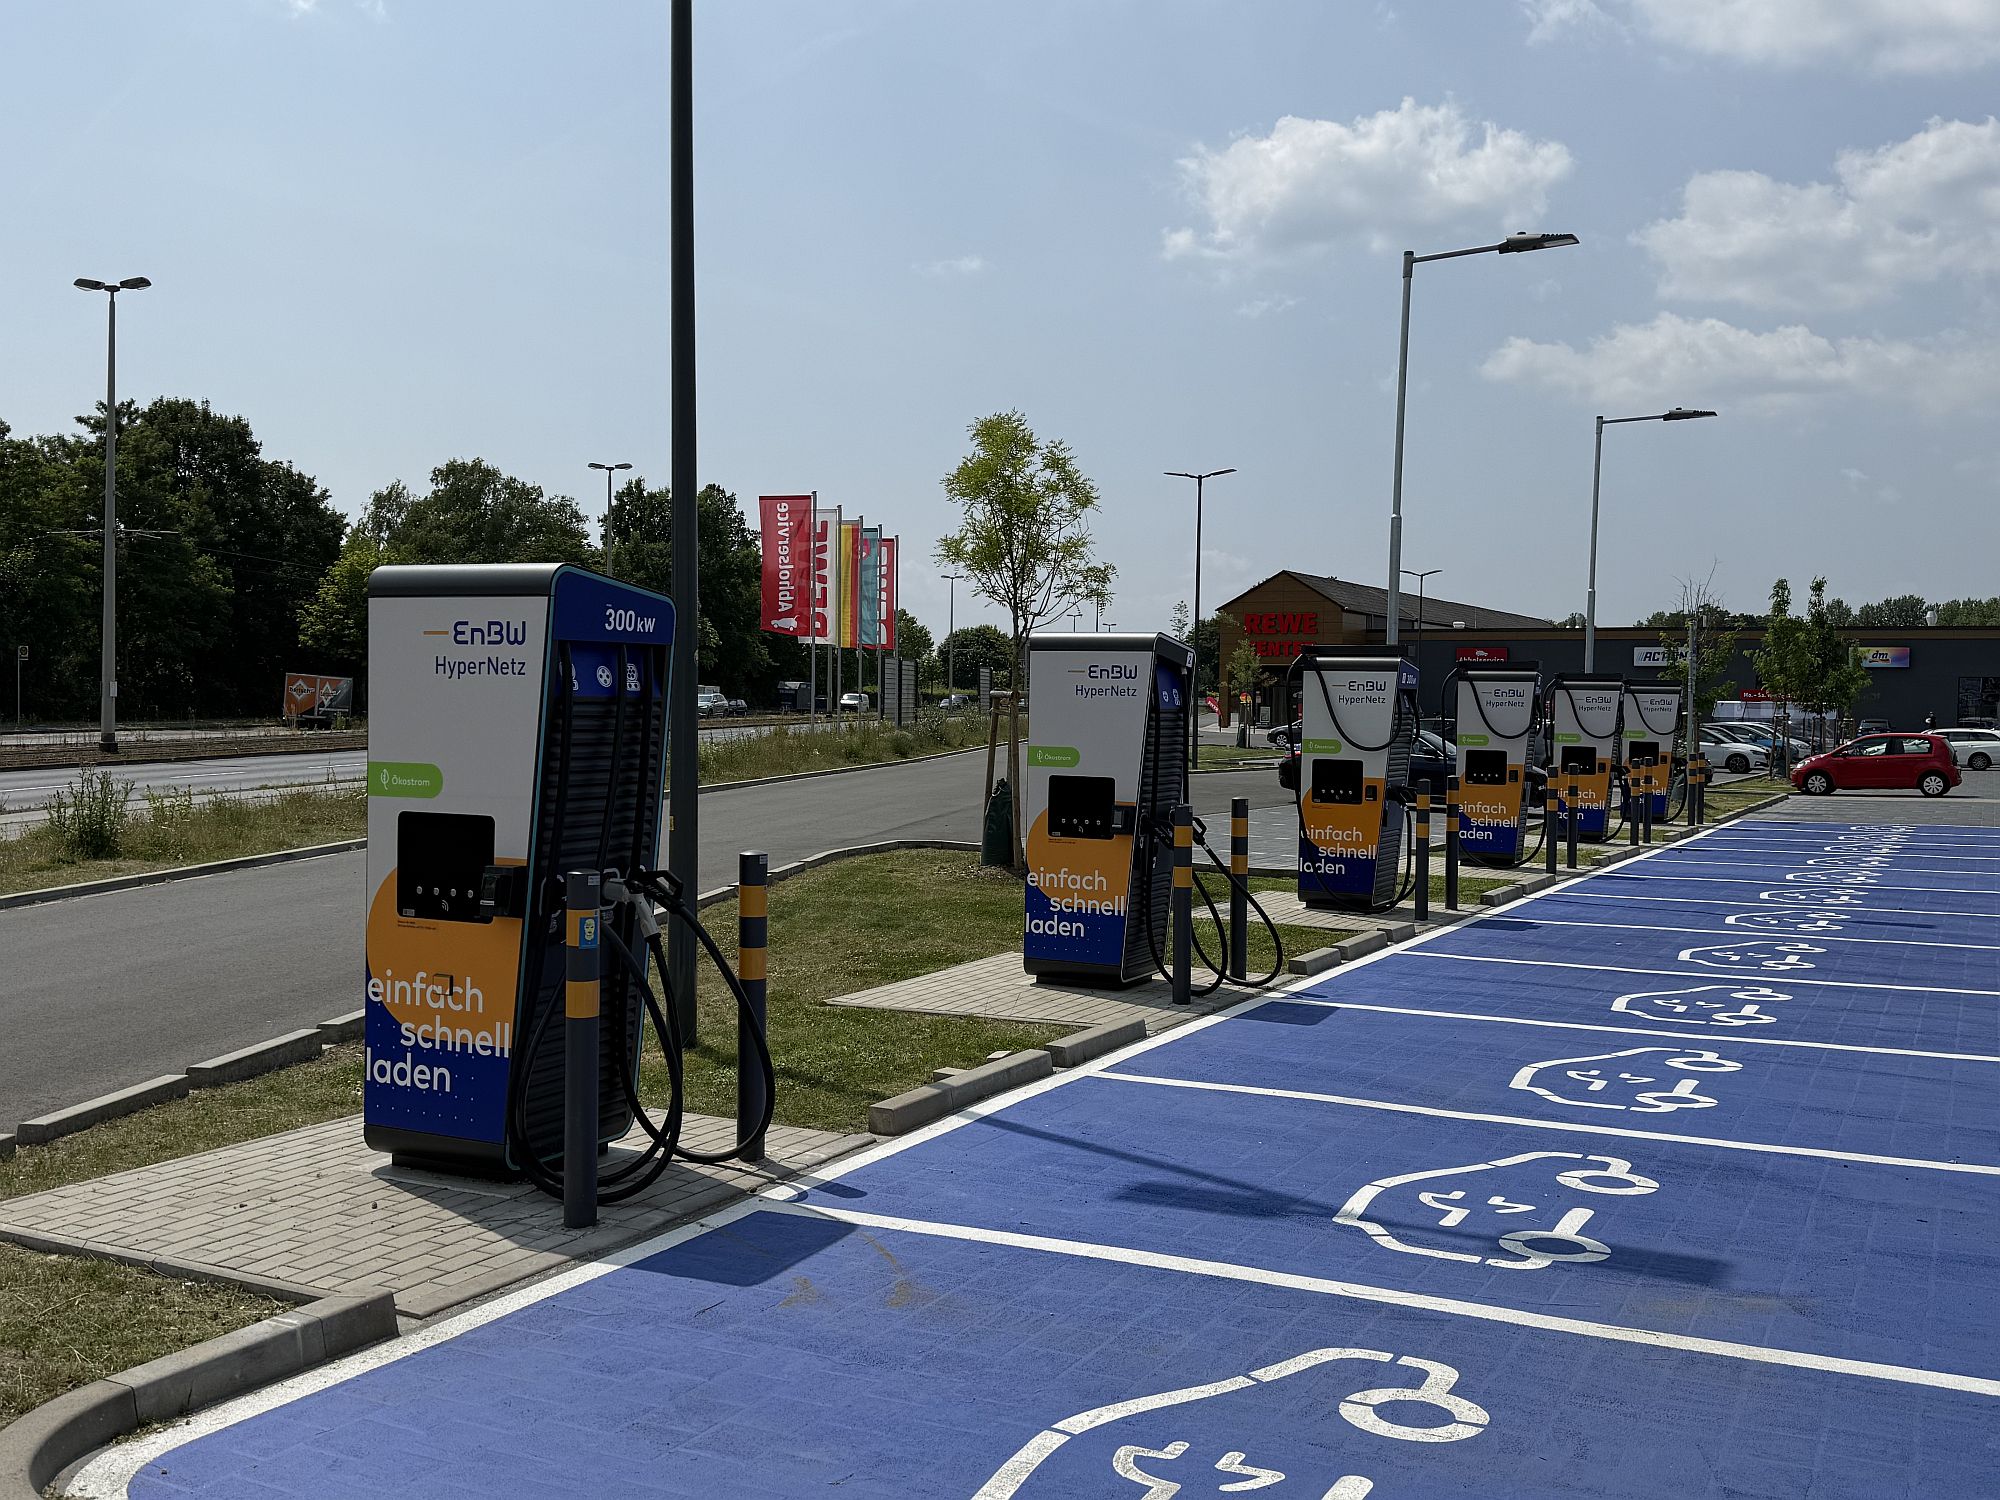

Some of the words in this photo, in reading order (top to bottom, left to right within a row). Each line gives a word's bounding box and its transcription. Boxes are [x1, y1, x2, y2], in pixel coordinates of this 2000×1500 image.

[1244, 613, 1318, 634] REWE
[453, 620, 527, 646] EnBW
[1249, 640, 1317, 657] ENTE
[1643, 651, 1688, 662] ACTN
[1872, 650, 1888, 659] dm
[435, 655, 527, 680] HyperNetz
[1088, 664, 1138, 680] EnBW
[1075, 684, 1138, 698] HyperNetz
[1348, 680, 1387, 691] EnBW
[1493, 688, 1525, 698] EnBW
[1338, 695, 1386, 705] HyperNetz
[1485, 700, 1525, 708] HyperNetz
[1585, 696, 1612, 704] EnBW
[1649, 698, 1673, 706] EnBW
[391, 775, 430, 787] Ökostrom
[1470, 814, 1518, 828] schnell
[1458, 827, 1493, 840] aden
[1318, 843, 1377, 860] schnell
[1299, 857, 1345, 875] laden
[1026, 866, 1107, 891] einfach
[1049, 892, 1125, 916] schnell
[1025, 912, 1085, 938] laden
[367, 968, 484, 1014] einfach
[400, 1015, 510, 1058] schnell
[365, 1046, 451, 1093] laden
